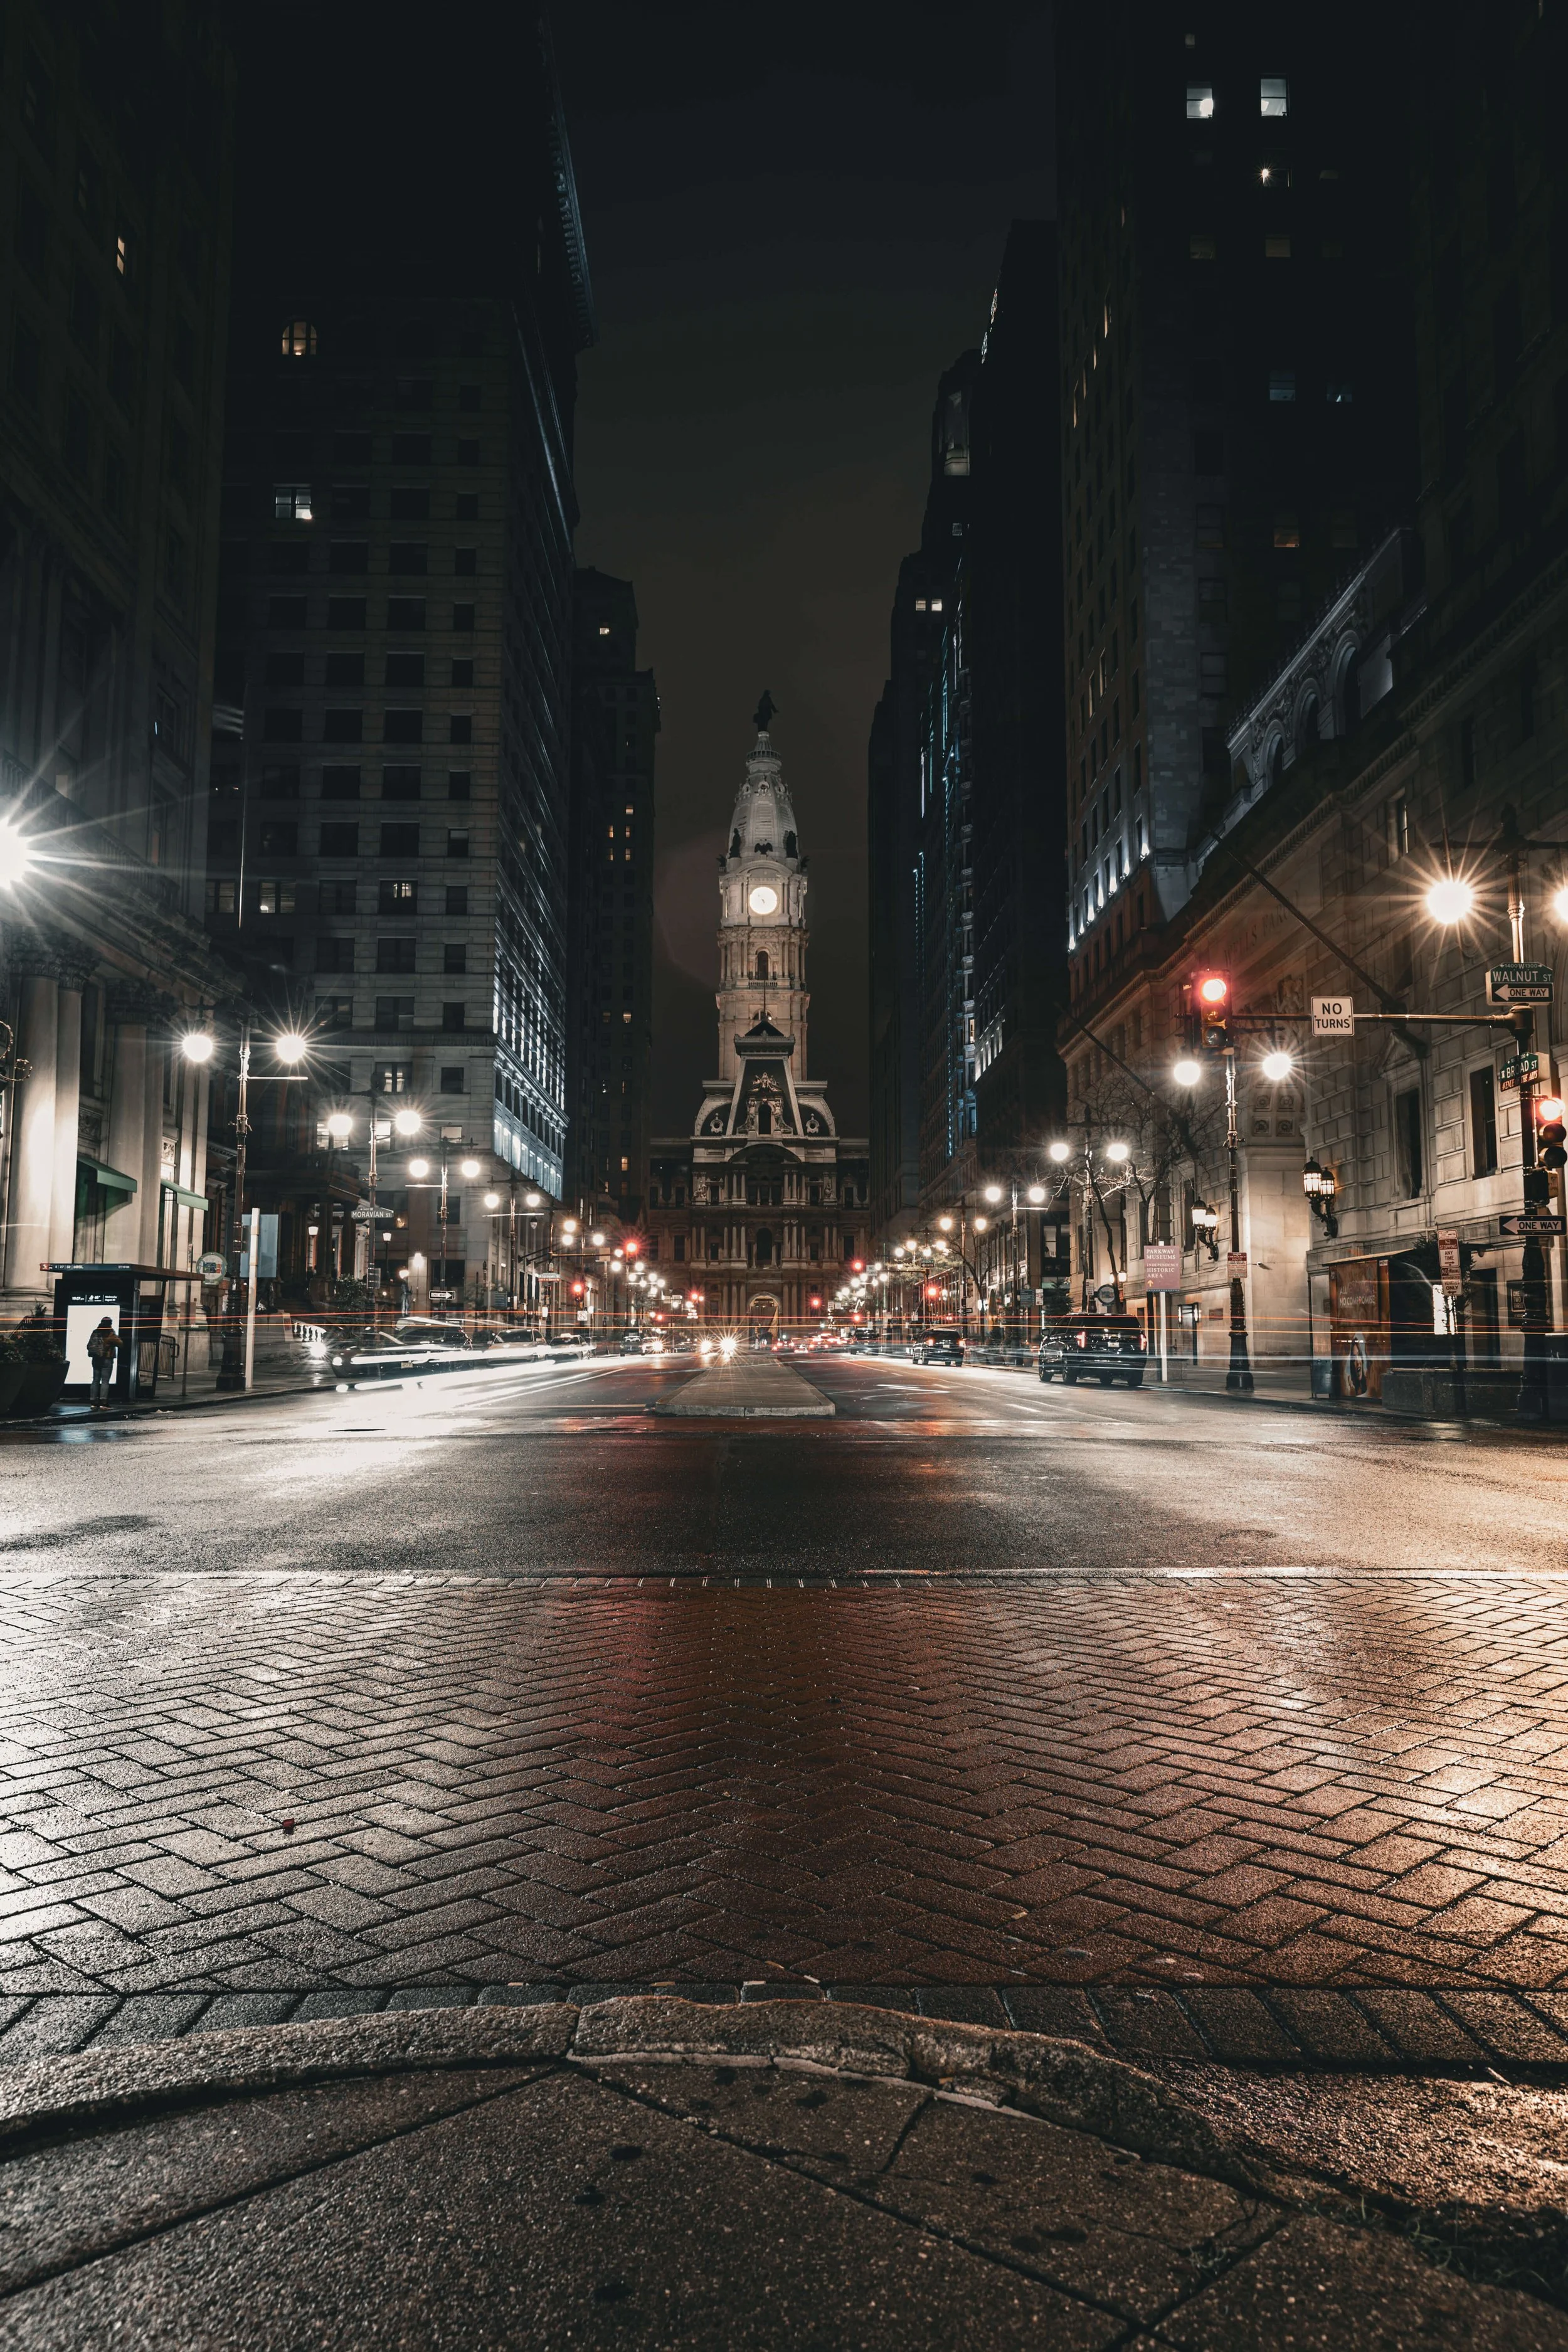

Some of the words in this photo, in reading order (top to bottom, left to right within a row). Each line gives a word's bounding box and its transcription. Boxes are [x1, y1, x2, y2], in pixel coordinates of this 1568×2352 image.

[1493, 971, 1539, 982] WALNUT
[1322, 1003, 1342, 1015] NO
[1315, 1019, 1350, 1028] TURNS
[1507, 1060, 1529, 1078] BROAD
[1531, 1060, 1537, 1069] ST
[1518, 1221, 1537, 1229] ONE
[1540, 1221, 1559, 1229] WAY
[1339, 1297, 1347, 1306] NO
